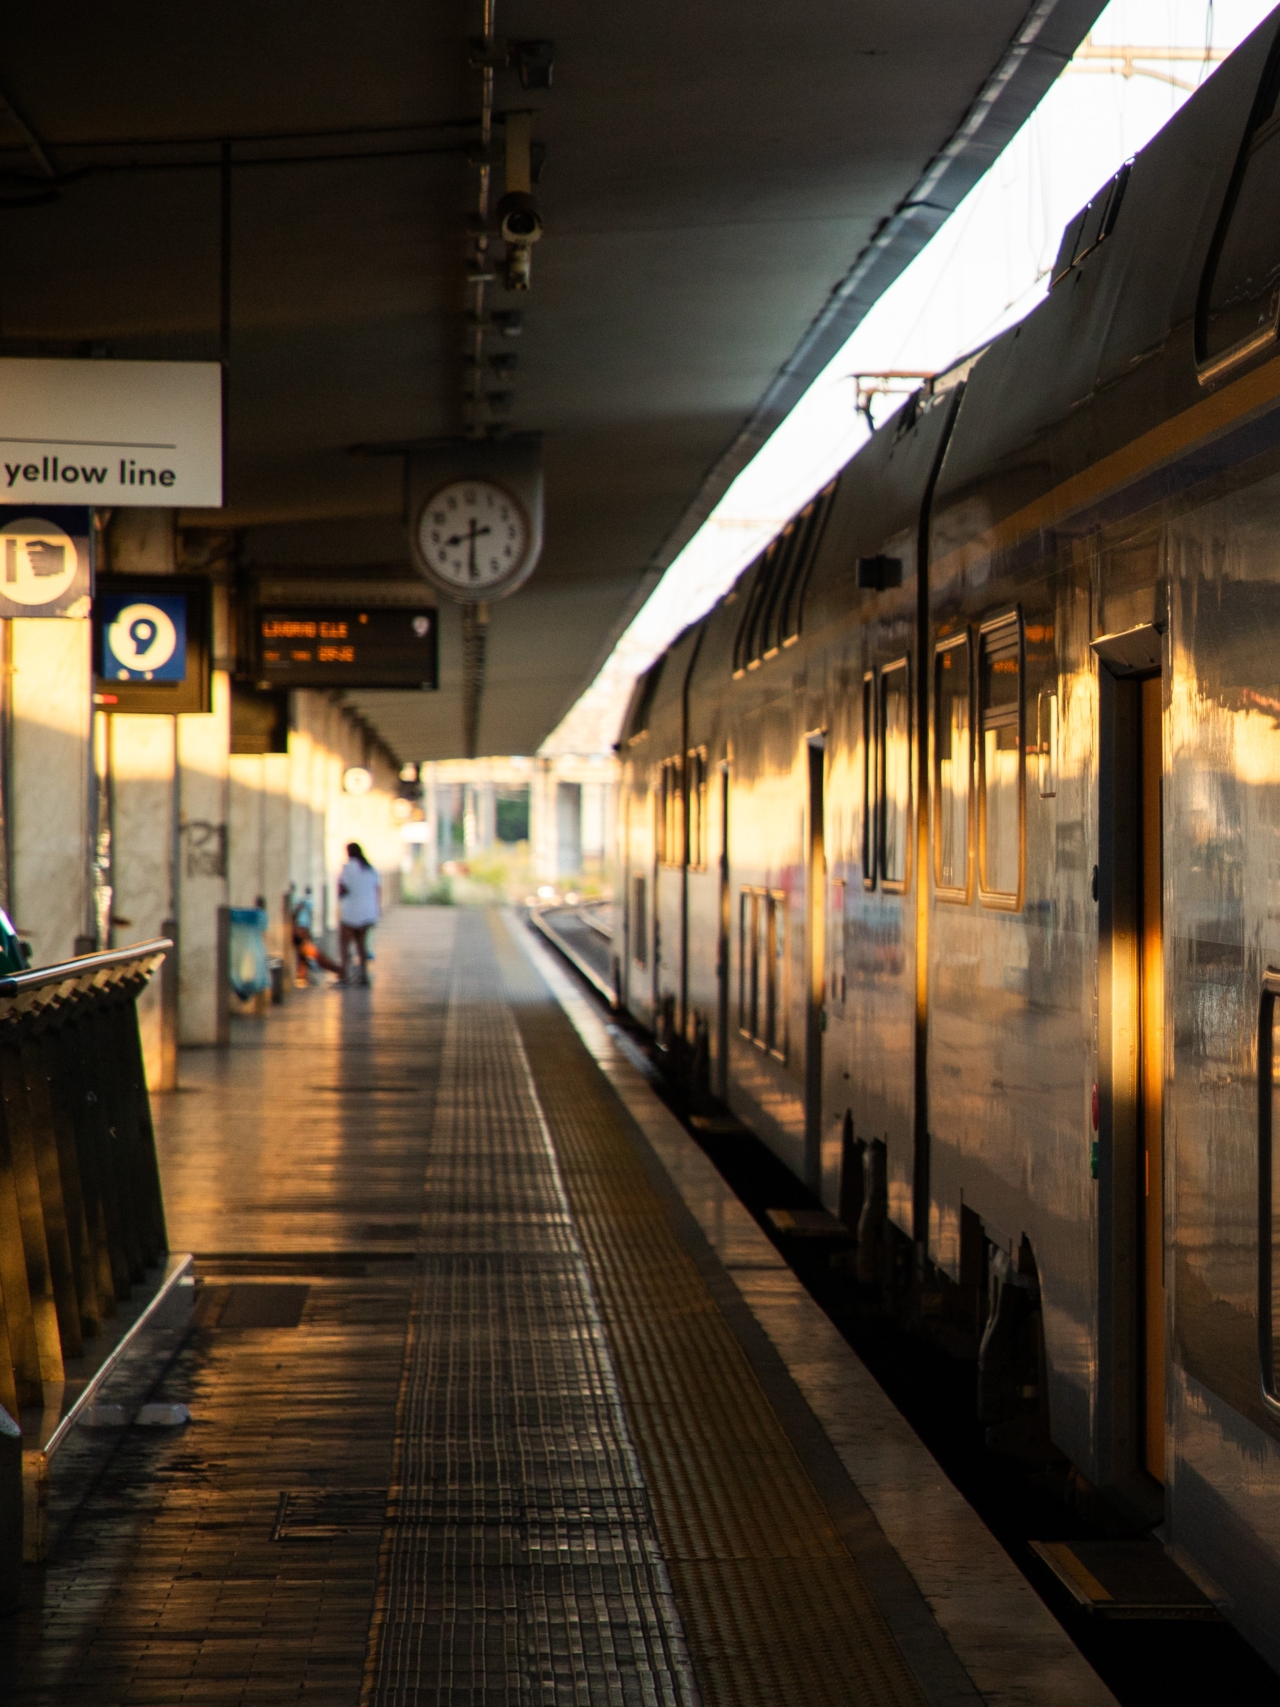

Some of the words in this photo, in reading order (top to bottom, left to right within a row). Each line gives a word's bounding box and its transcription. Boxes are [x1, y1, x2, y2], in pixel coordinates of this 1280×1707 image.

[5, 456, 107, 488] yellow
[120, 459, 176, 487] line
[129, 618, 158, 655] 9
